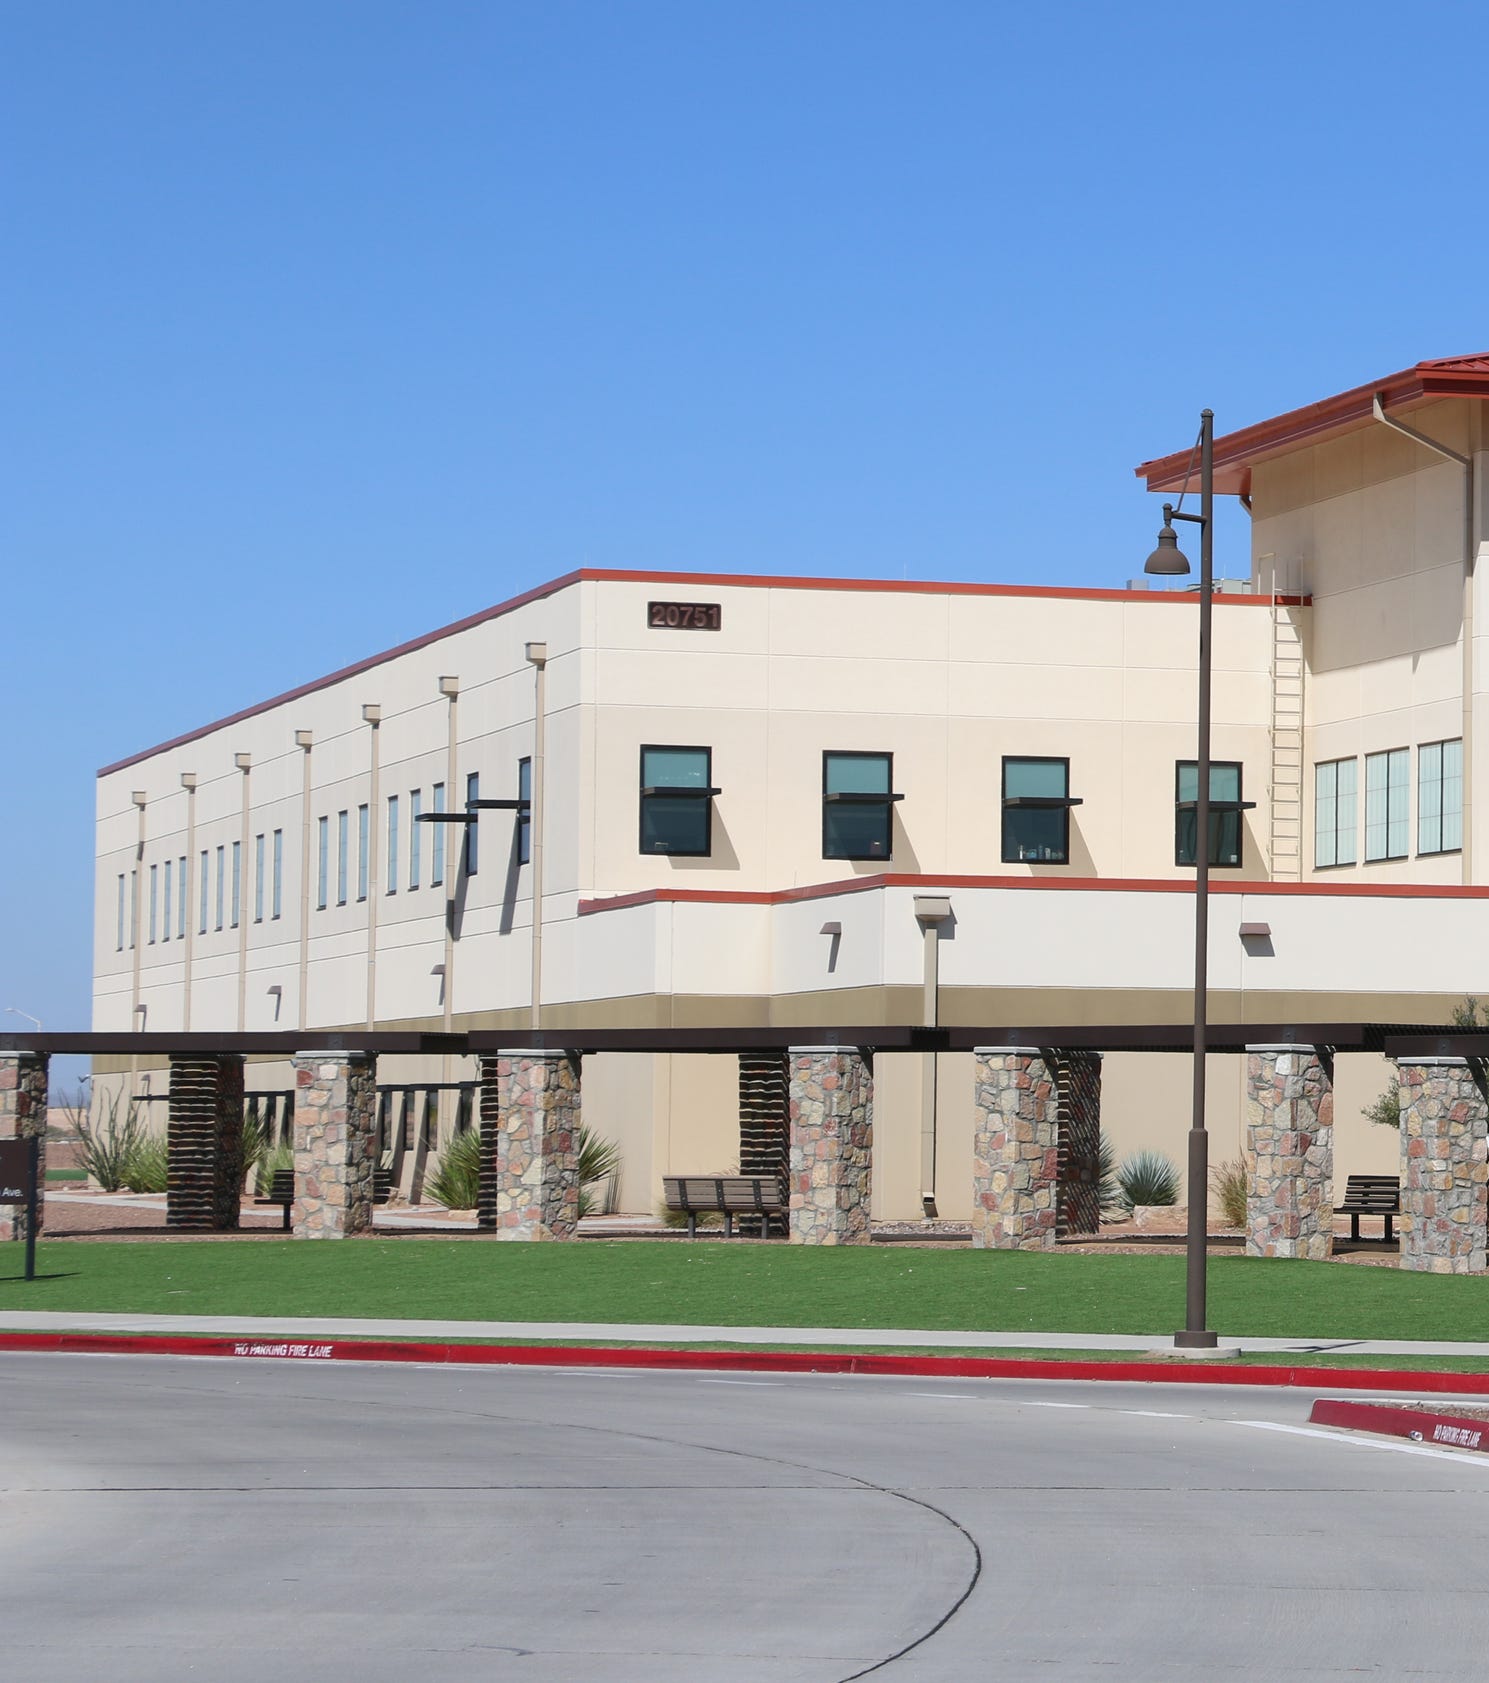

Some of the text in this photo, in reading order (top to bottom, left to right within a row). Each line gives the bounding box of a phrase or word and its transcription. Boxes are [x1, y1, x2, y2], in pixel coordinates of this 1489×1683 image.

[652, 605, 718, 627] 20751
[1, 1187, 24, 1197] Ave.
[234, 1343, 334, 1358] NO PARKING FIRE LANE
